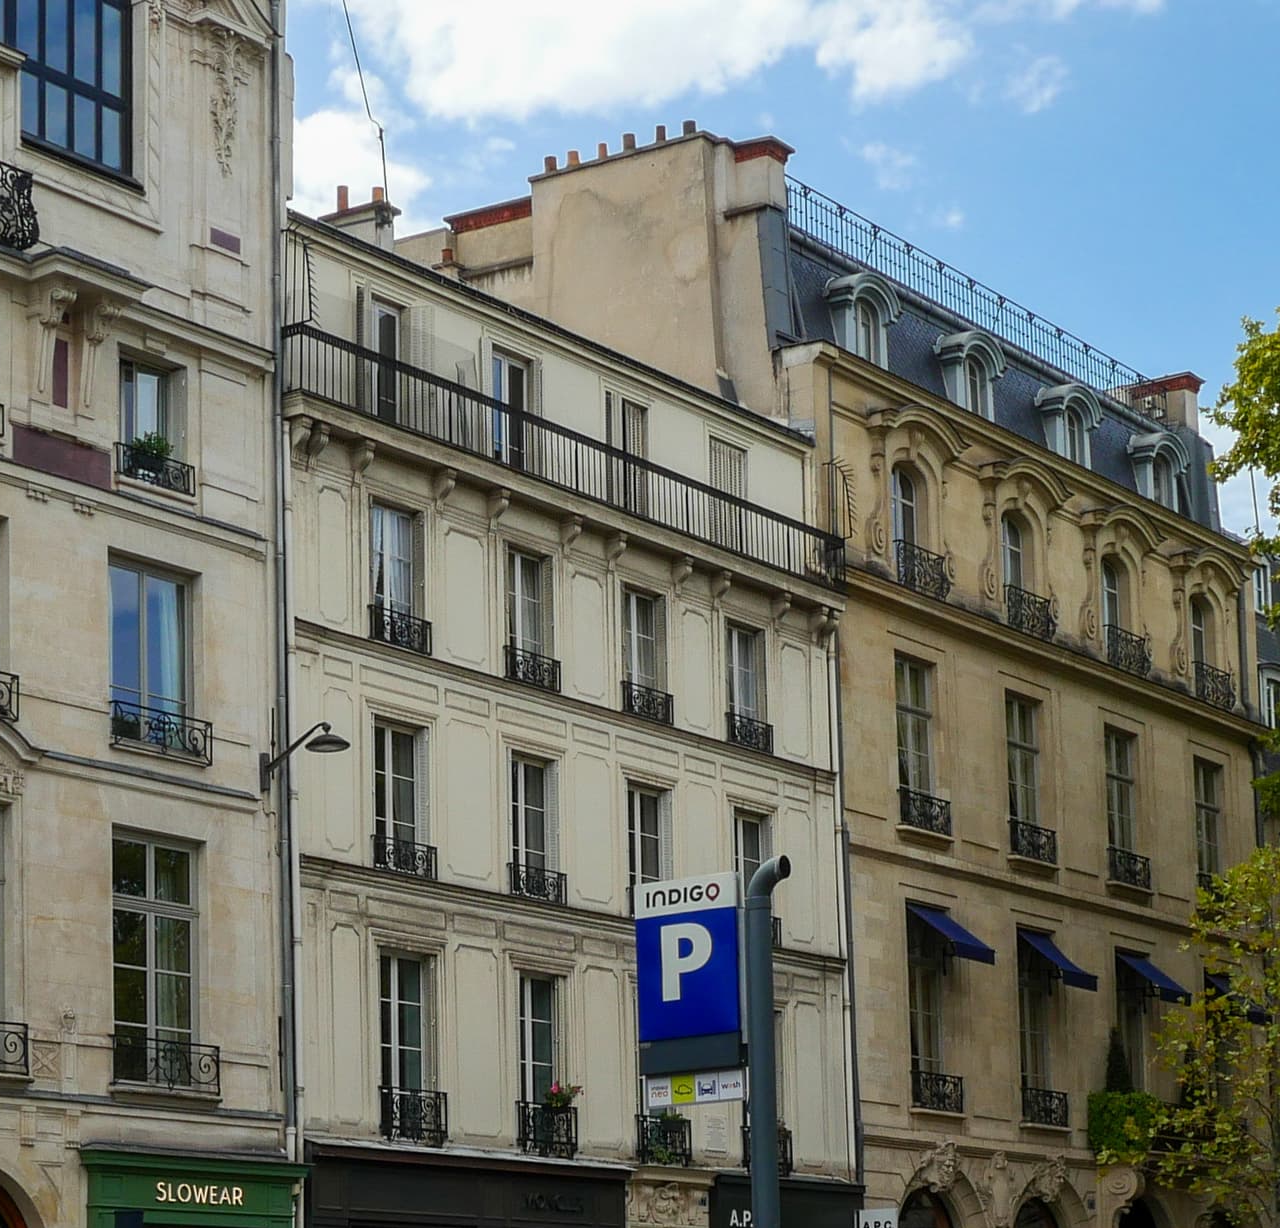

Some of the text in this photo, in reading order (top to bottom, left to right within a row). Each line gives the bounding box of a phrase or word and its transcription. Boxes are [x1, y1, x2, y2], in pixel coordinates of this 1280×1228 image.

[660, 922, 712, 1002] P
[156, 1182, 243, 1206] SLOWEAR
[729, 1209, 754, 1228] A.P.
